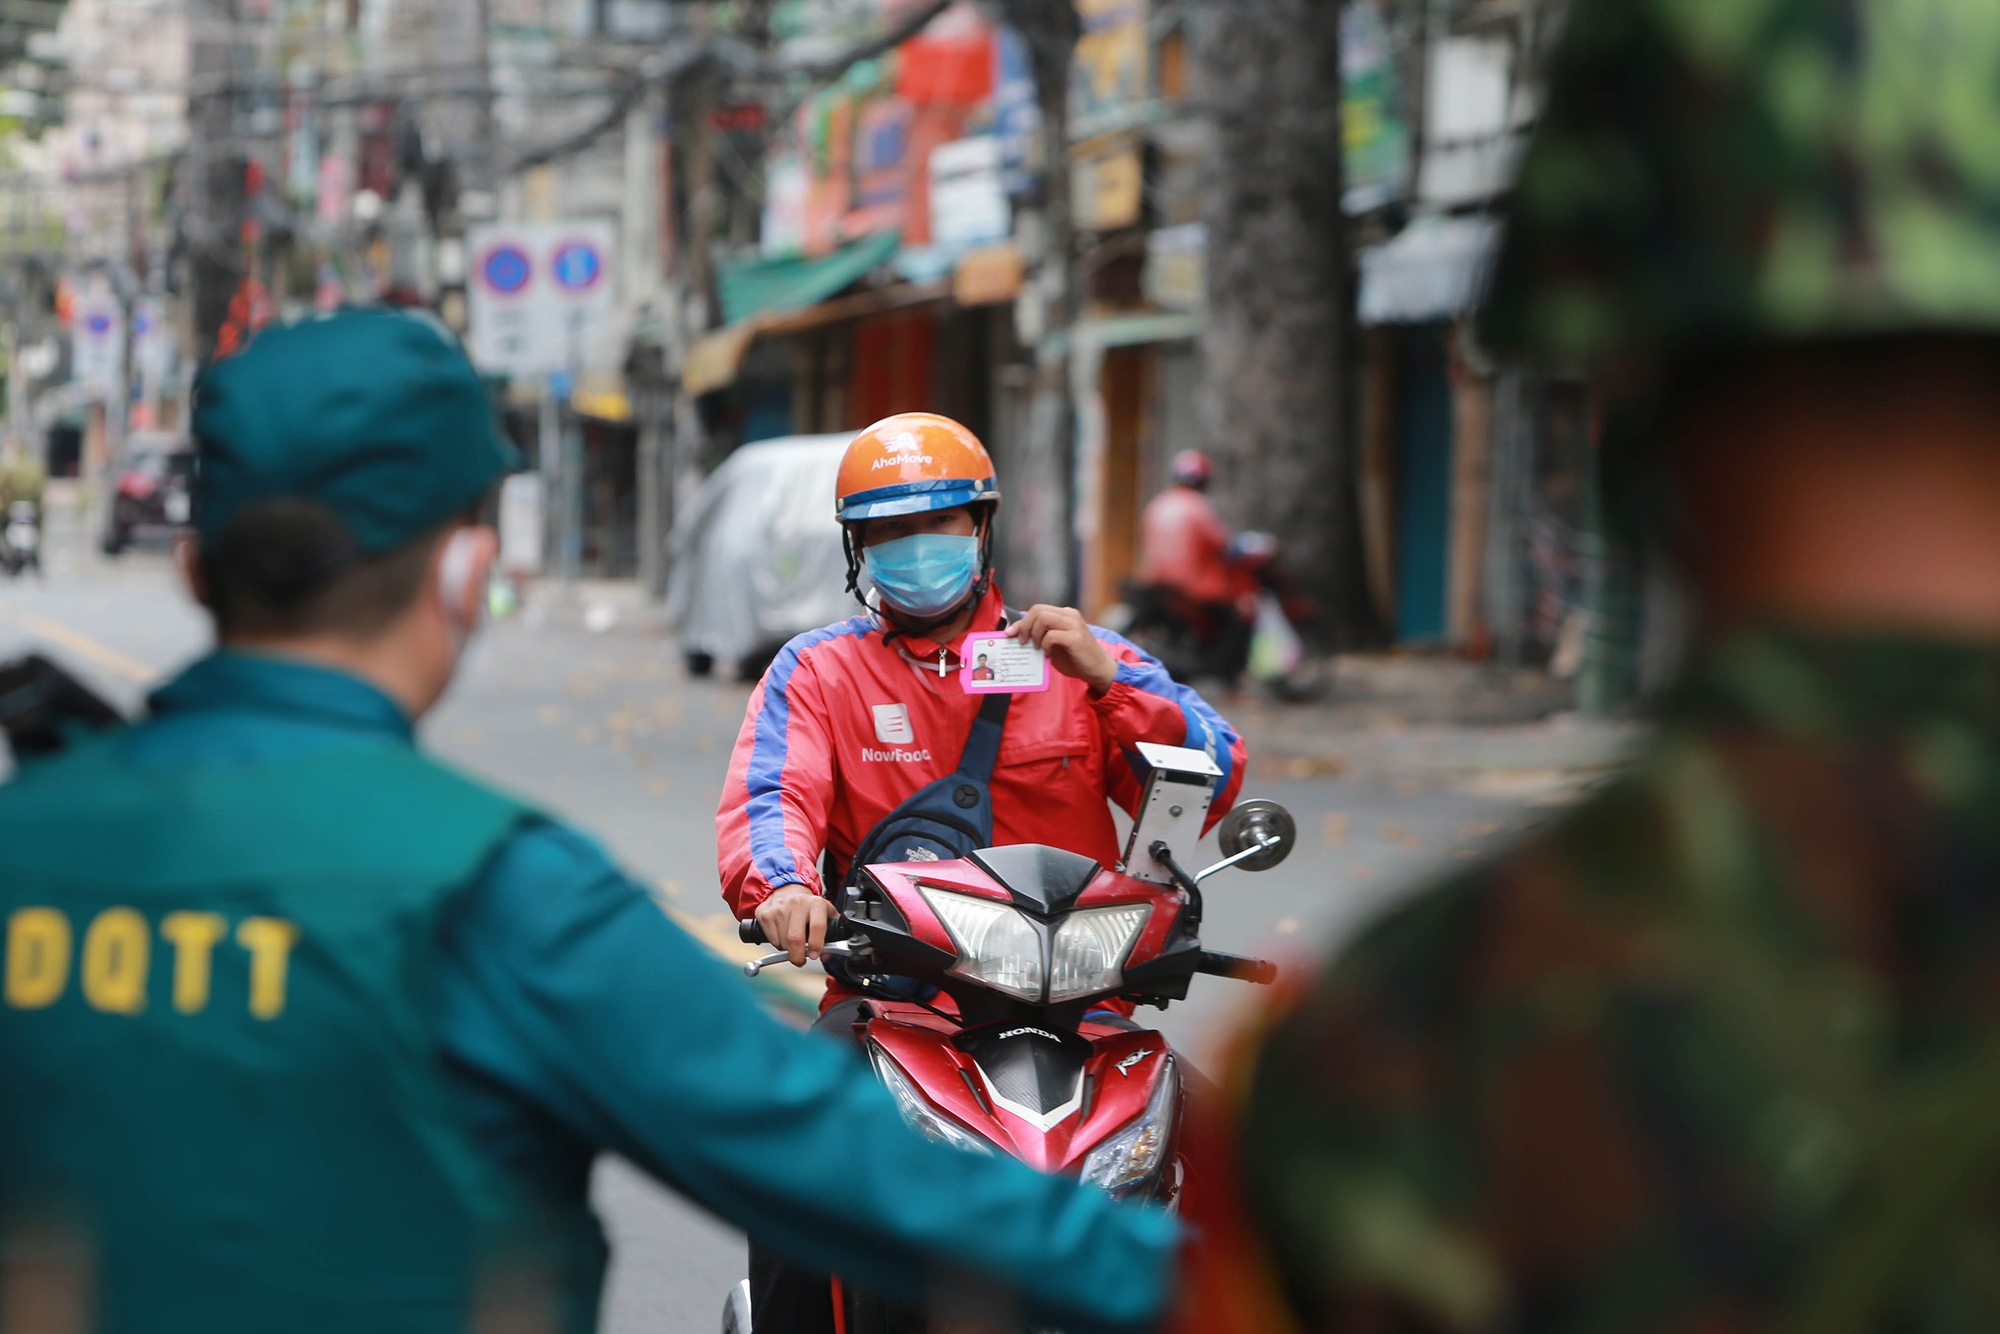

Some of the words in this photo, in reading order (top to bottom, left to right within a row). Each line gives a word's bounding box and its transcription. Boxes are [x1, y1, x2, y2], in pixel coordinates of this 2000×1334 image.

[870, 453, 933, 471] AhaMove
[4, 904, 300, 1021] DQTT
[998, 1026, 1062, 1043] HONDA
